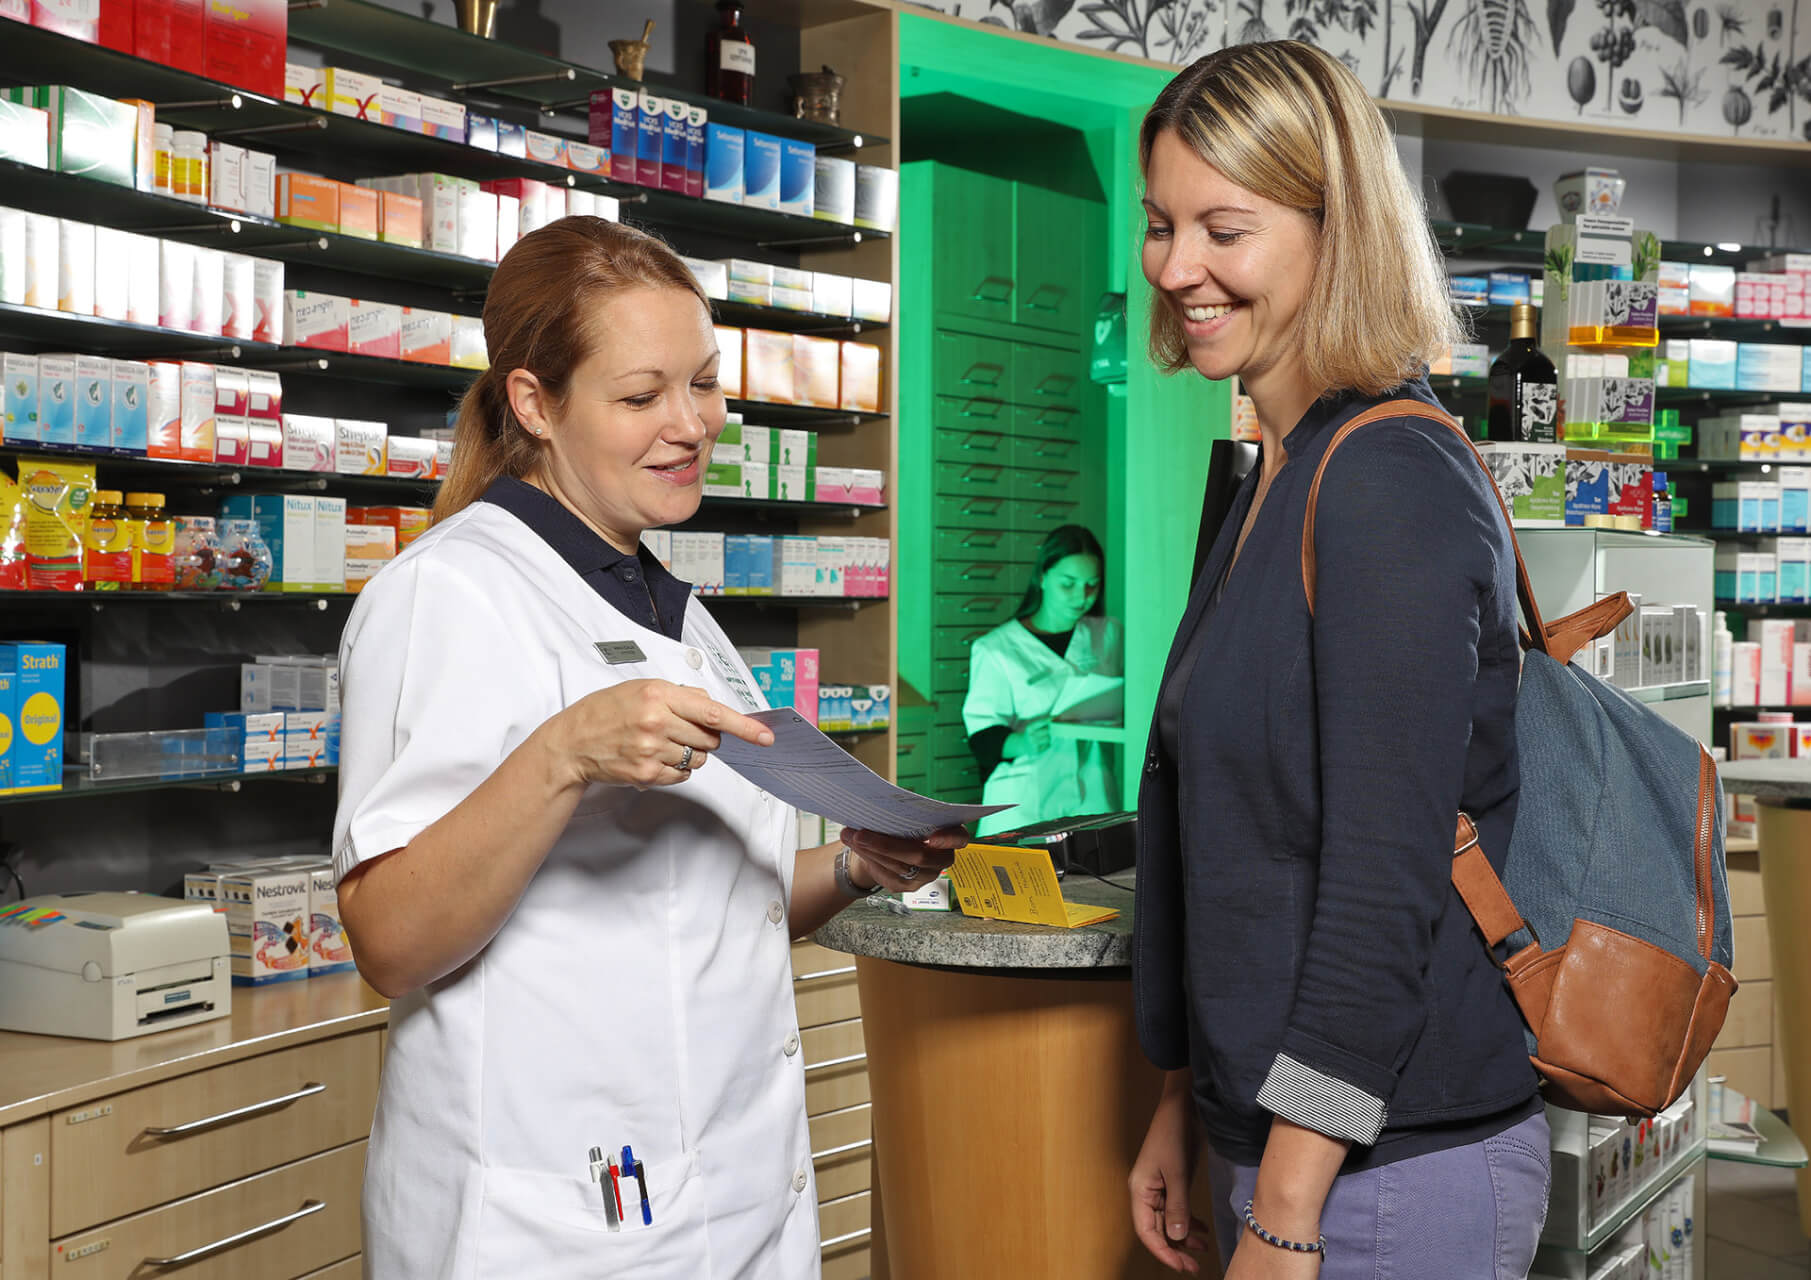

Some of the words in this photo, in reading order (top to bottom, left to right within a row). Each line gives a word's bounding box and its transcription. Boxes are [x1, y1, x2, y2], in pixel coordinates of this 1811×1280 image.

[287, 499, 312, 512] Nitux
[317, 500, 343, 513] Nitux
[22, 654, 59, 669] Strath
[24, 711, 57, 728] Original
[257, 882, 306, 899] Nestrovit
